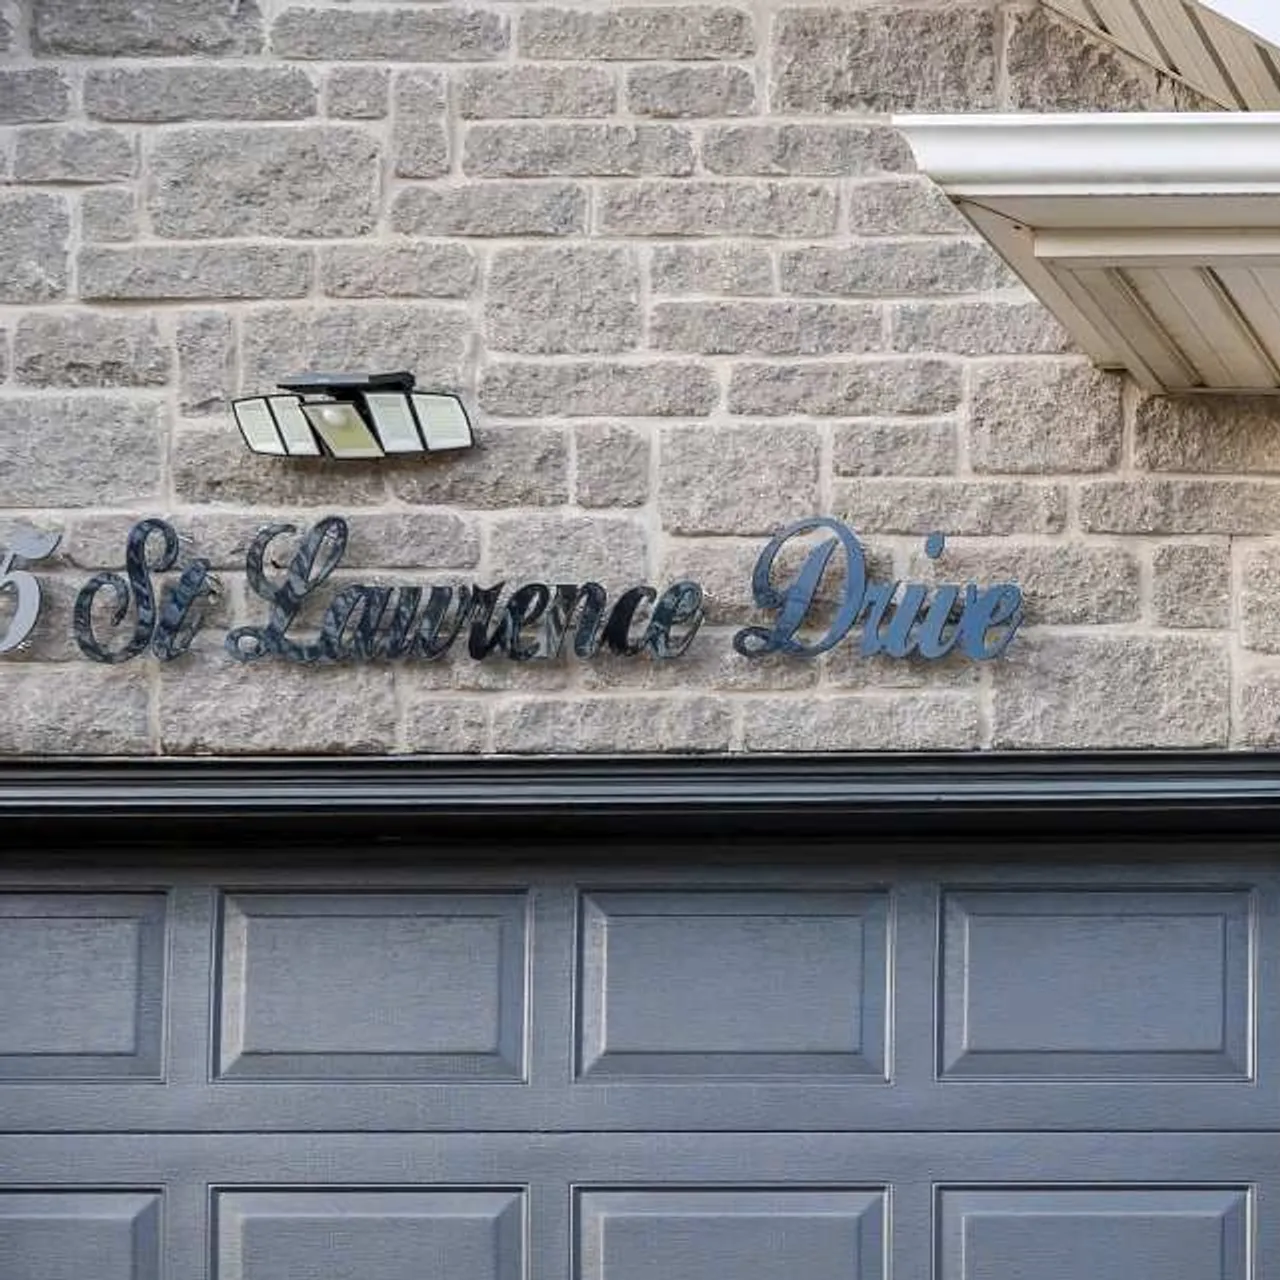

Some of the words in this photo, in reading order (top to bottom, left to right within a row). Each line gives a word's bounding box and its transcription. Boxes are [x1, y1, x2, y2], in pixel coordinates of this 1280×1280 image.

[73, 518, 212, 664] St
[225, 516, 704, 661] Lawrence
[732, 515, 1025, 661] Drive
